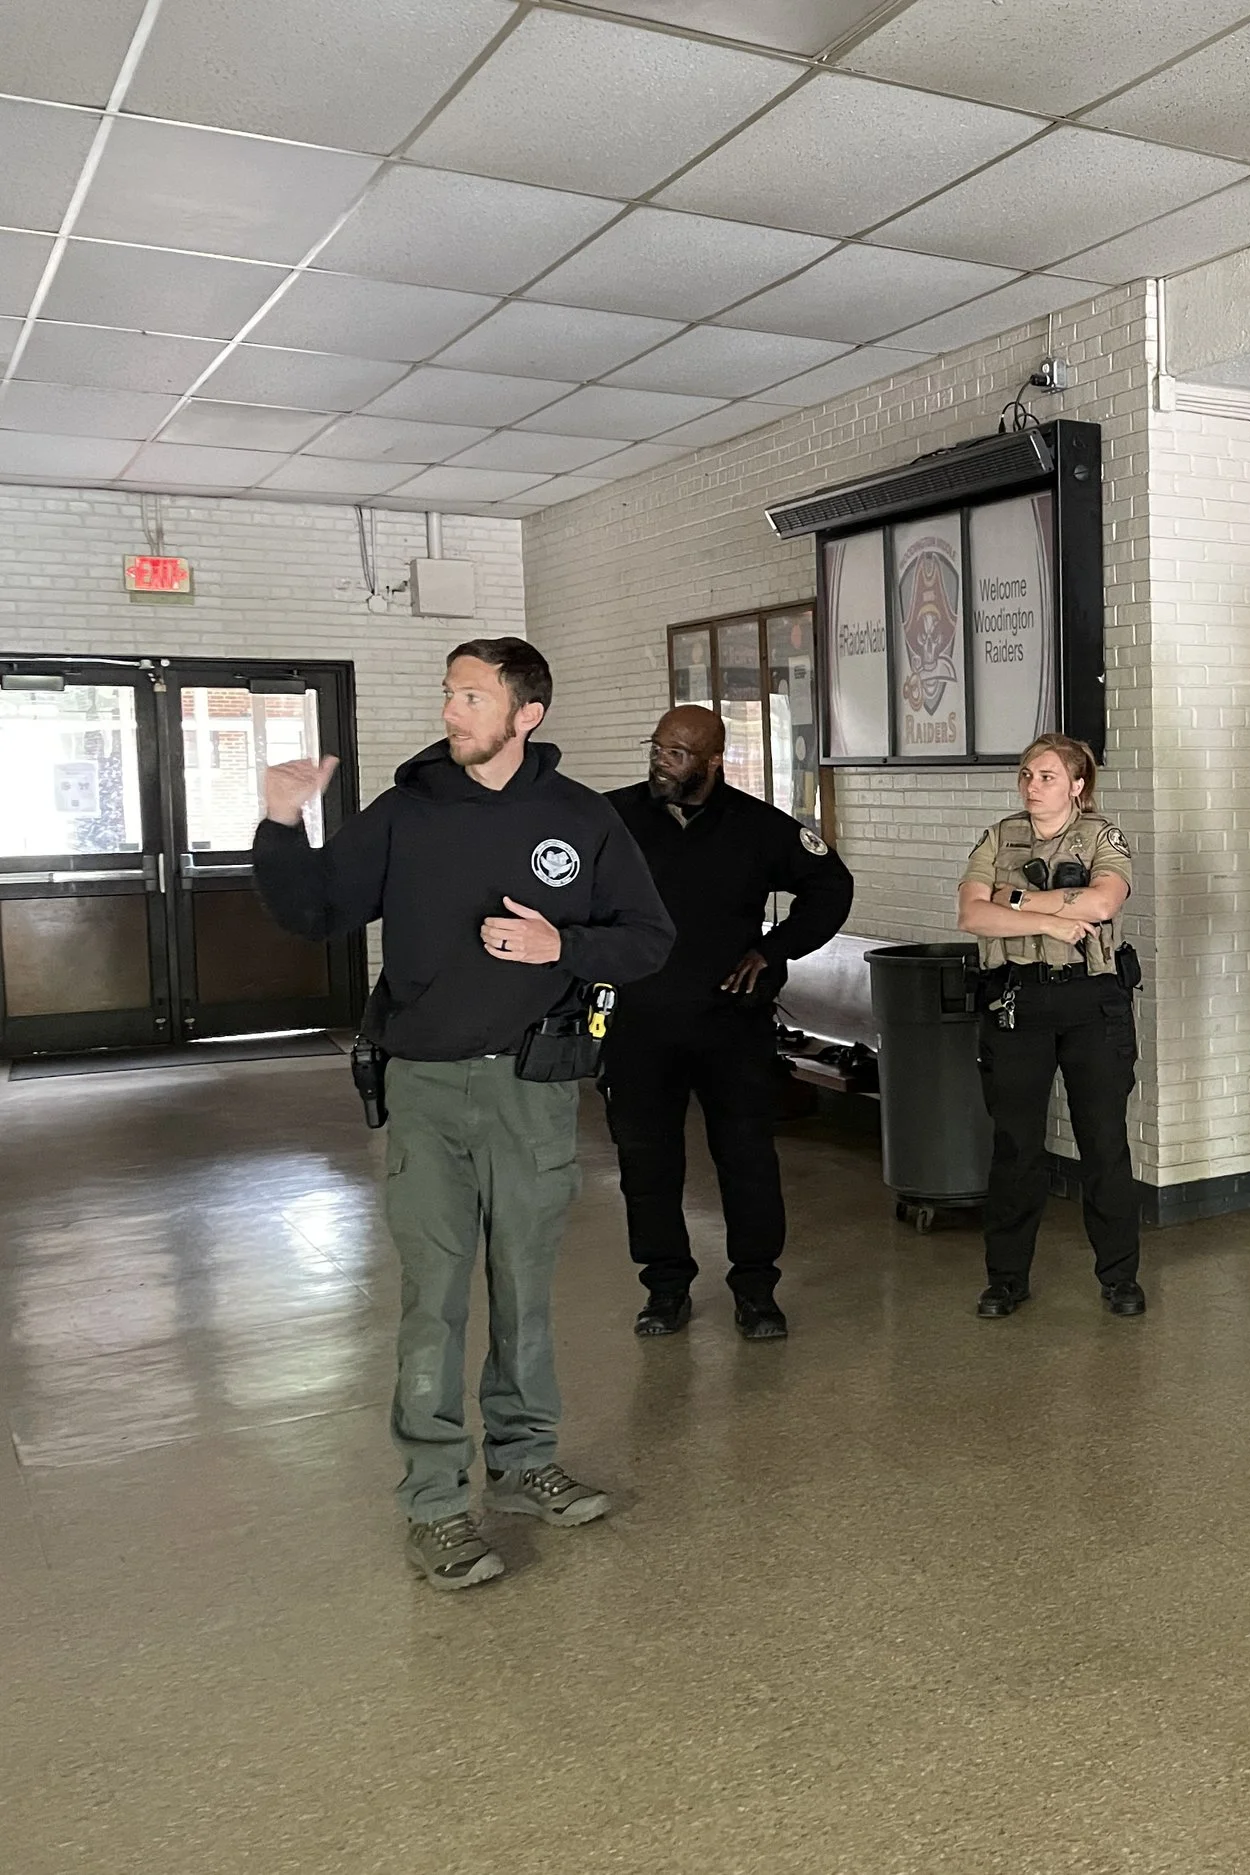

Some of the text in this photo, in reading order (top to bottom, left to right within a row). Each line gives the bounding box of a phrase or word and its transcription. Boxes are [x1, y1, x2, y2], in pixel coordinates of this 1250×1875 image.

[135, 556, 180, 590] EXIT
[979, 576, 1027, 602] Welcome
[973, 607, 1034, 636] Woodington
[985, 639, 1024, 663] Raiders
